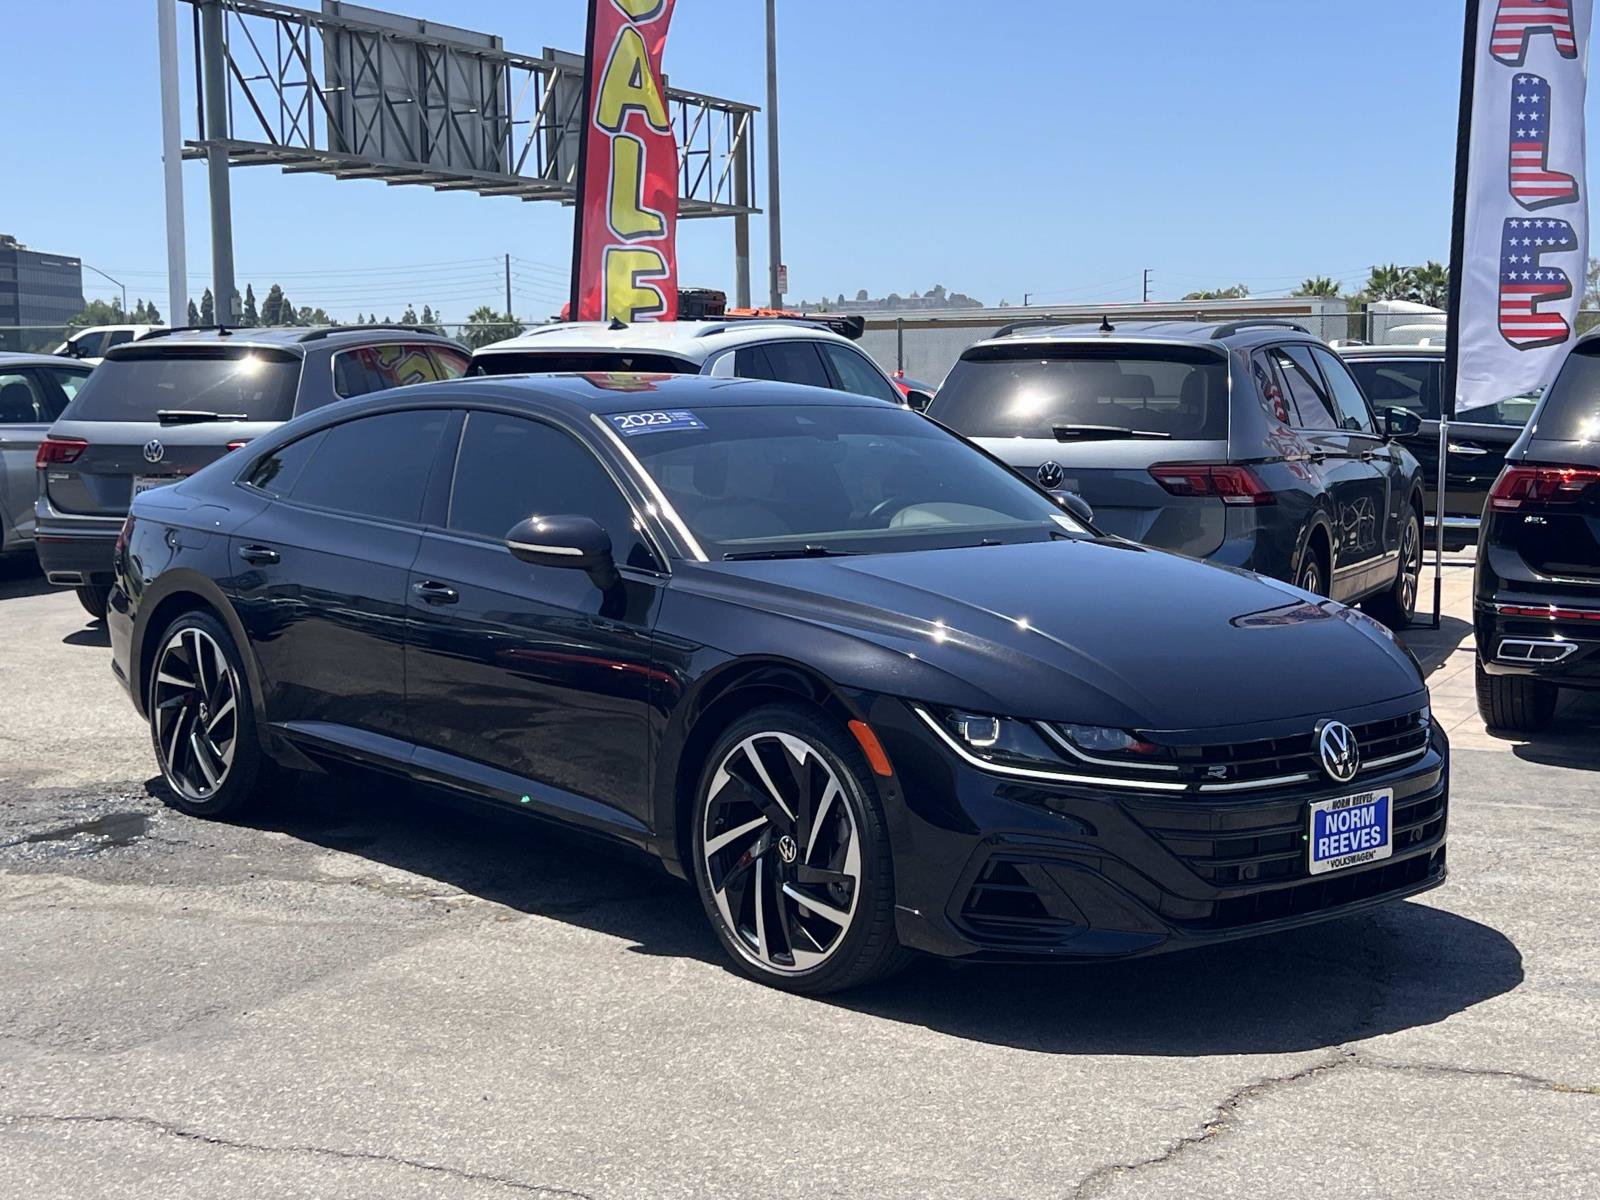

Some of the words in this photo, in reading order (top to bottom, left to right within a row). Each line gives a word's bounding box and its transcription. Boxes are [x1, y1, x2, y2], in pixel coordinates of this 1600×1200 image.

[594, 0, 671, 322] ALE
[614, 412, 672, 428] 2023
[1325, 805, 1375, 835] NORM
[1318, 825, 1381, 858] REEVES
